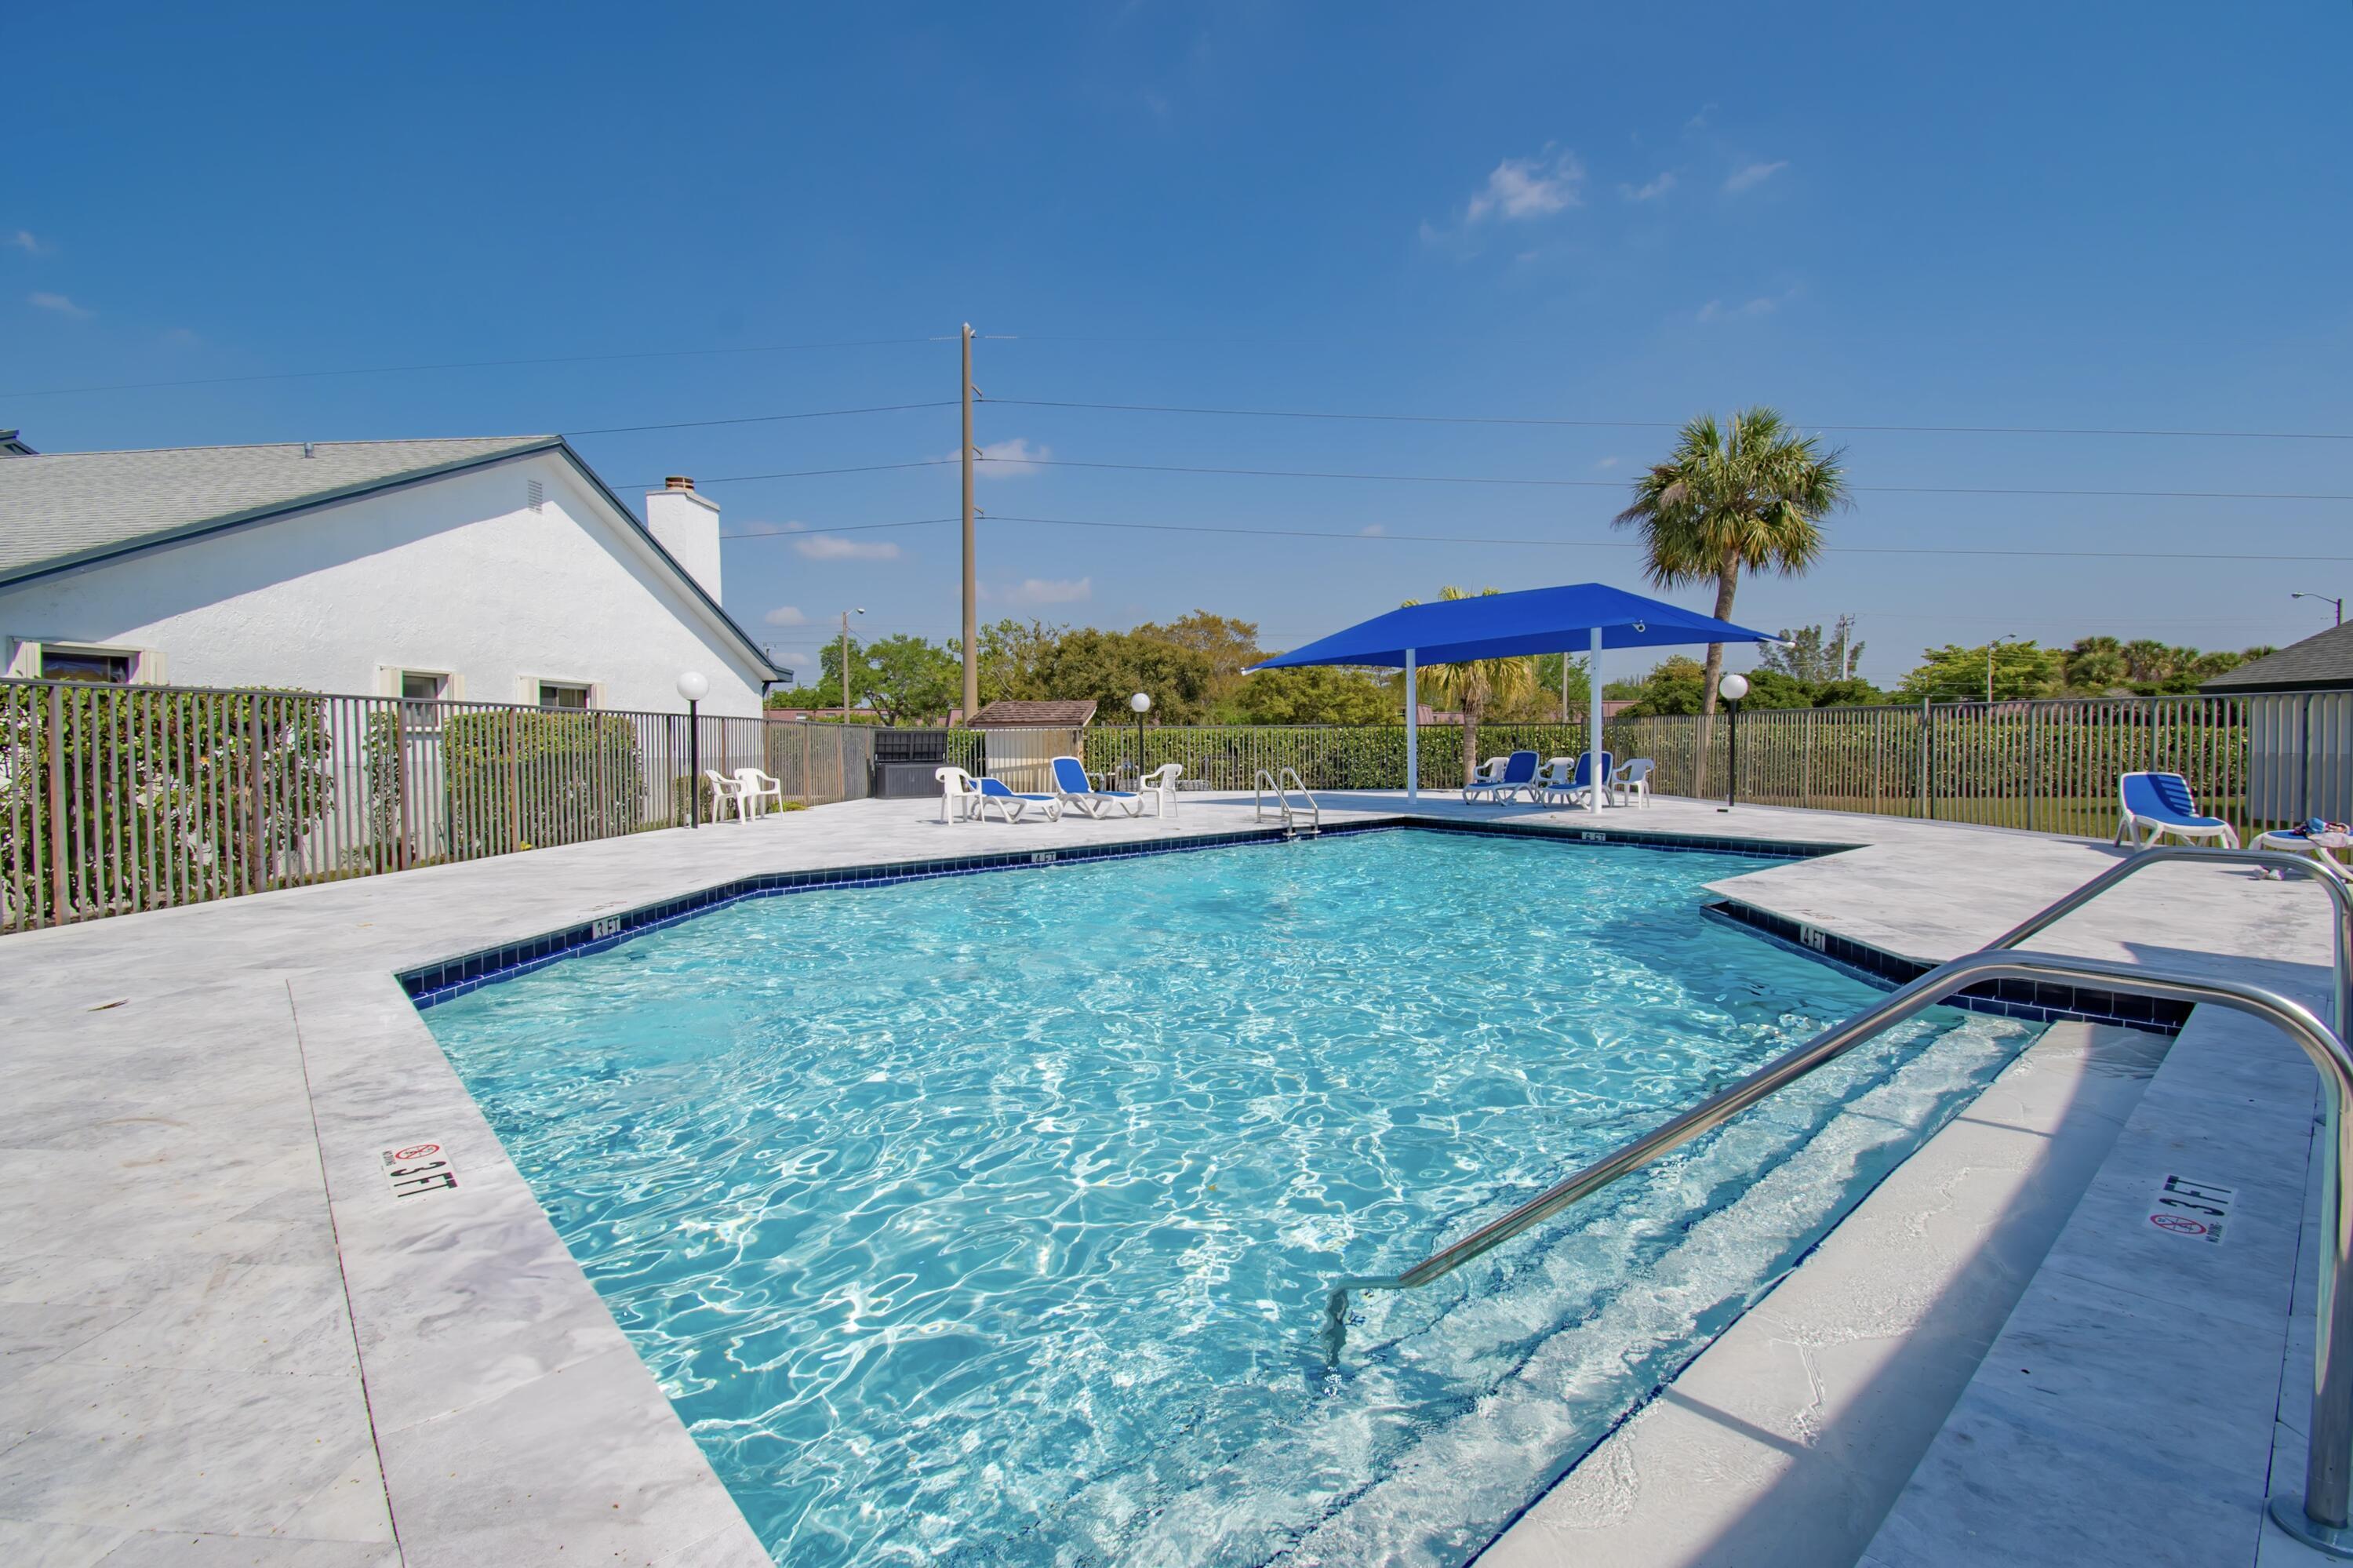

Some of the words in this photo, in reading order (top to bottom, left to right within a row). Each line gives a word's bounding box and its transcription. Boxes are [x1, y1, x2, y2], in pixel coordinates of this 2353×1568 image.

[1045, 853, 1055, 862] FT
[598, 922, 603, 938] 3
[607, 918, 619, 935] FT
[1804, 927, 1809, 944] 4
[1813, 930, 1824, 949] FT
[390, 1161, 446, 1177] 3
[394, 1172, 458, 1198] FT
[2163, 1175, 2231, 1204] FT
[2158, 1198, 2225, 1216] 3
